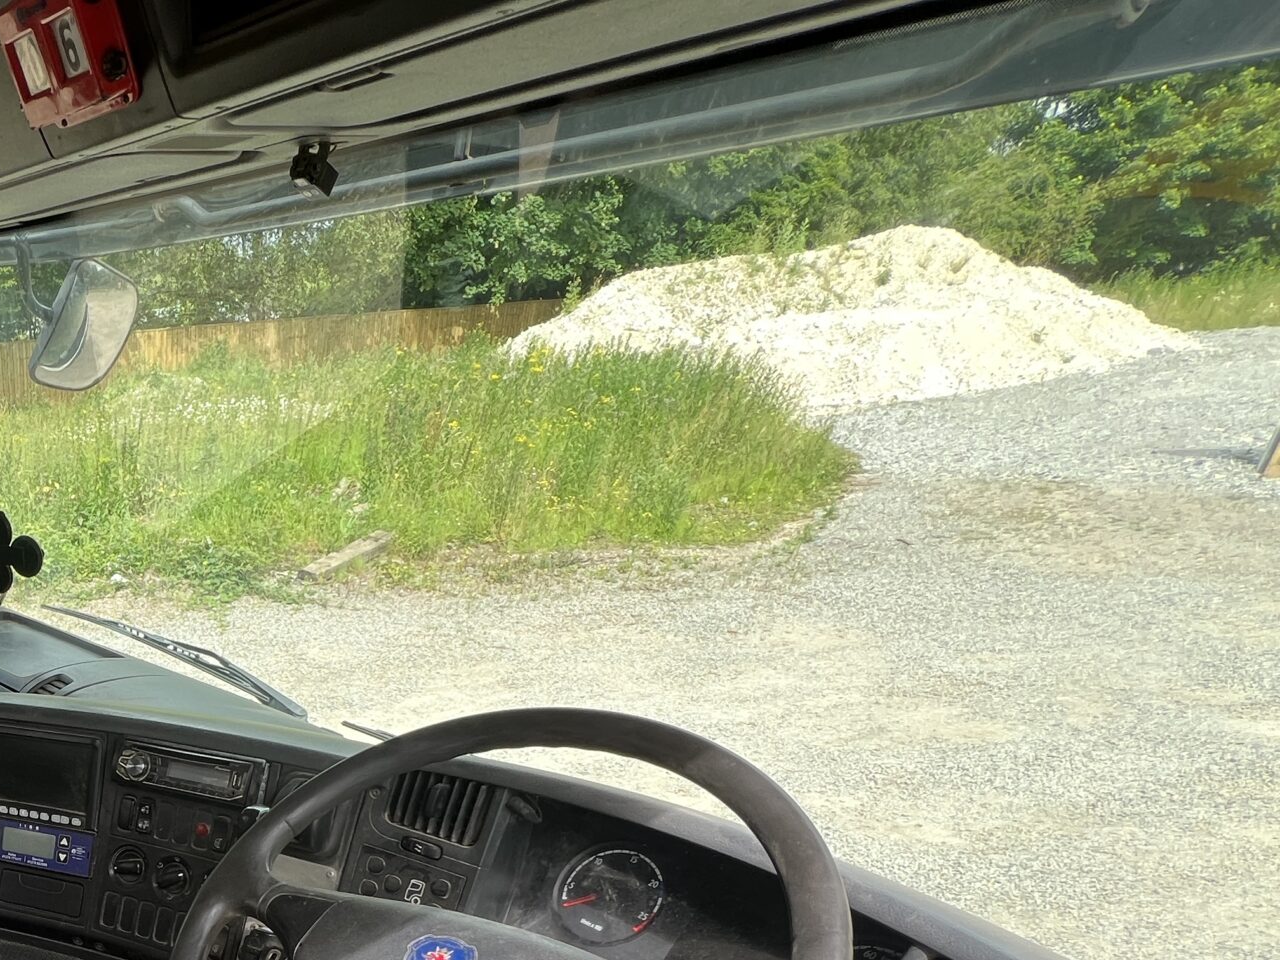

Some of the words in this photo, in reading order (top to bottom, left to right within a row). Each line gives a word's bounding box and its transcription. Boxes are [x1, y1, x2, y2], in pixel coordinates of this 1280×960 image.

[58, 18, 81, 72] 6
[648, 879, 659, 889] 20
[637, 911, 648, 921] 25
